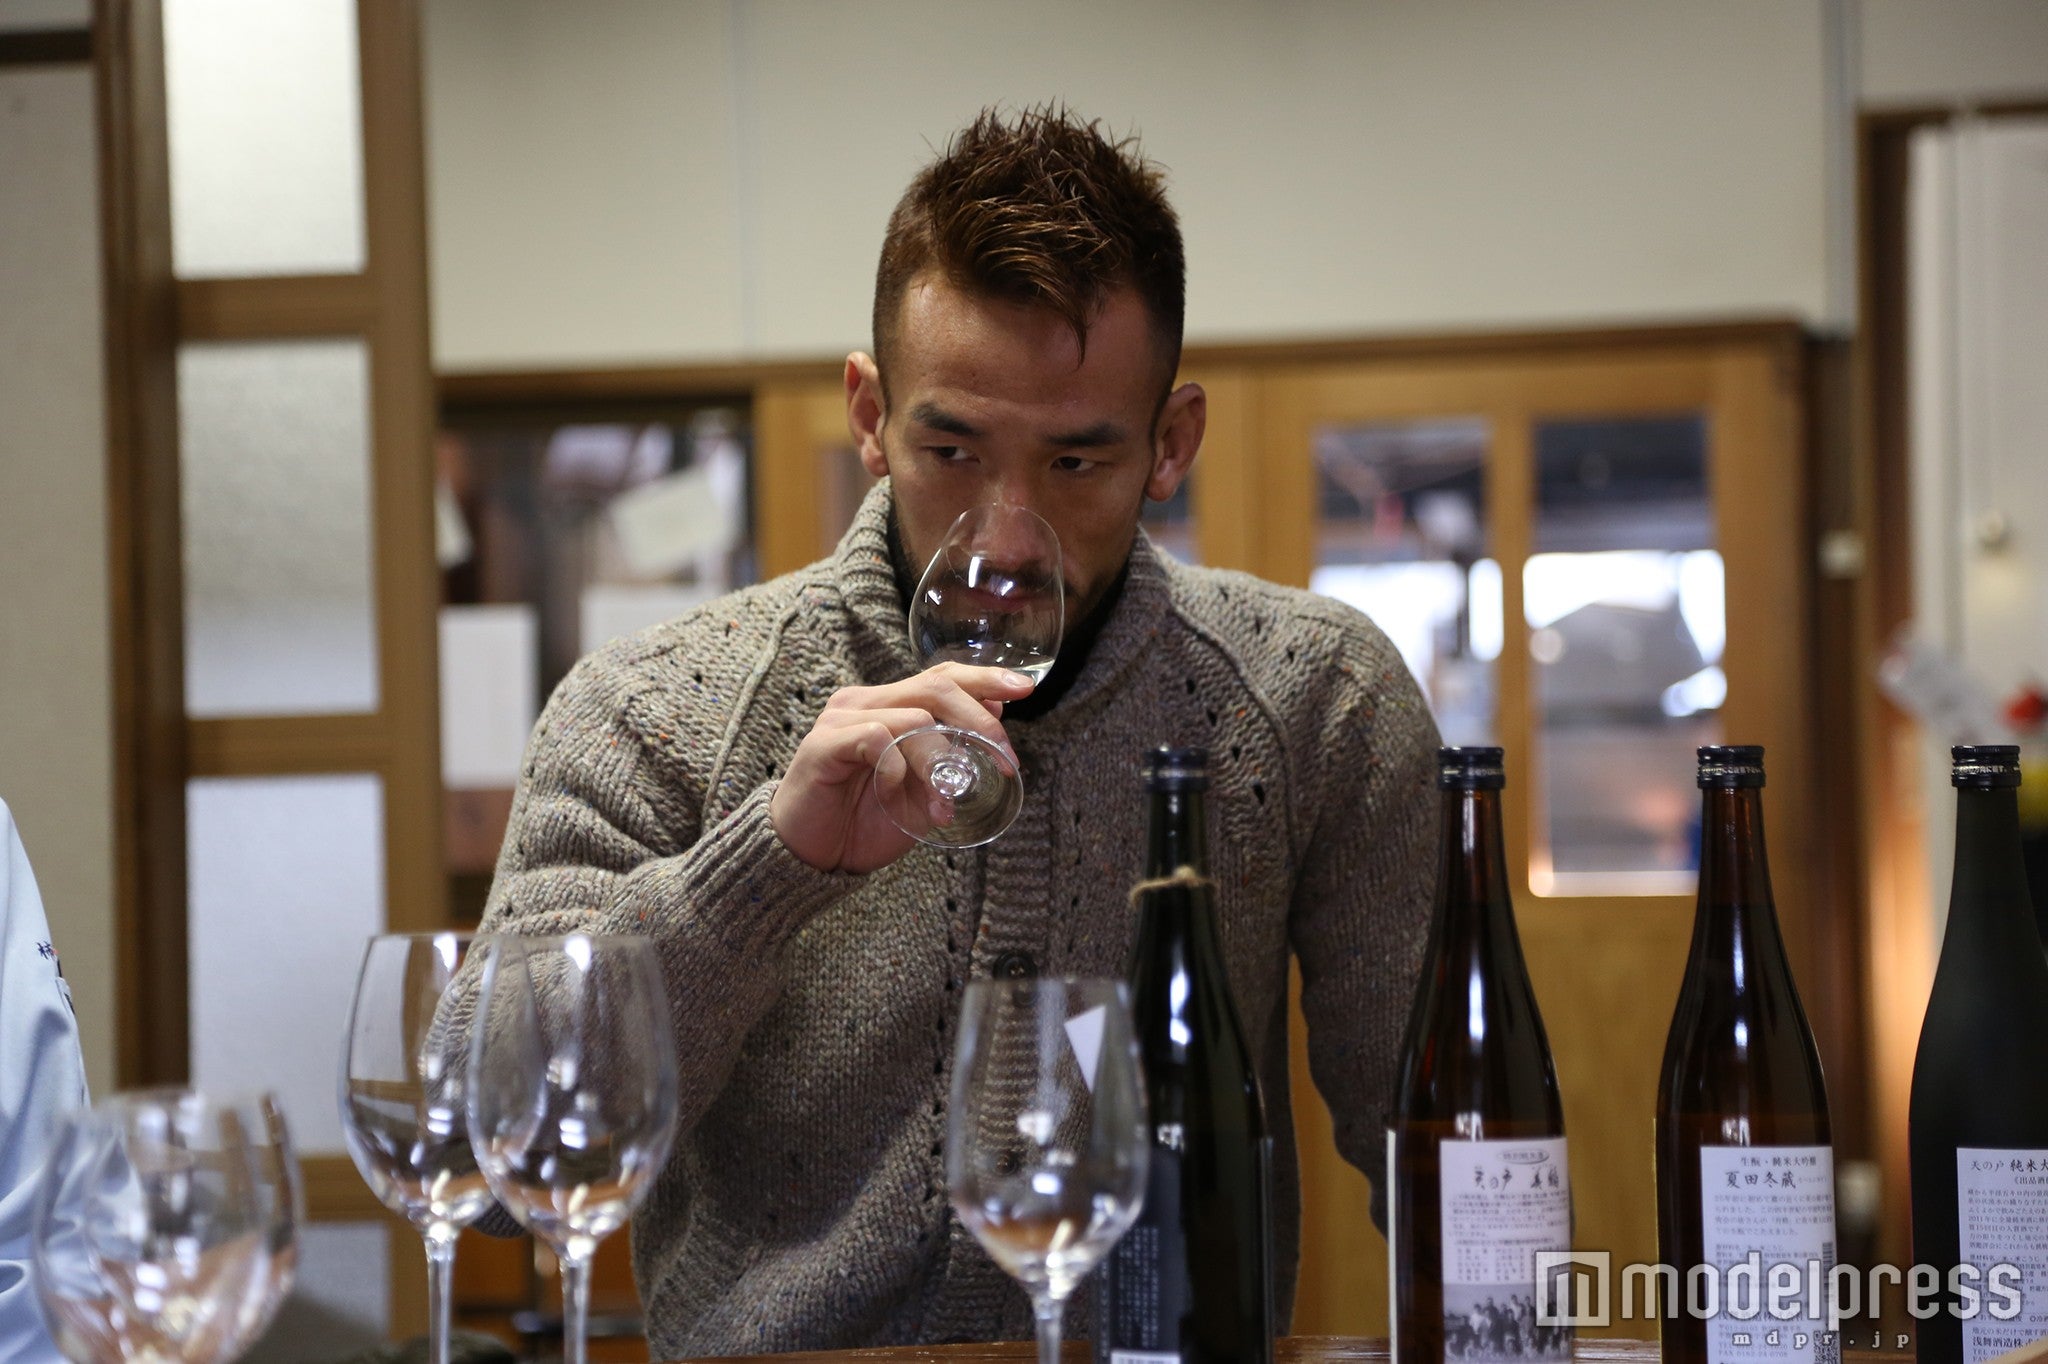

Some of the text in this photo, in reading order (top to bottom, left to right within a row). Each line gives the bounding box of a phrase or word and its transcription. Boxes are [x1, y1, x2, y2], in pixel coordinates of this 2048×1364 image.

[1971, 1158, 2048, 1173] 天の戸 純米大
[1725, 1170, 1797, 1189] 夏田冬蔵
